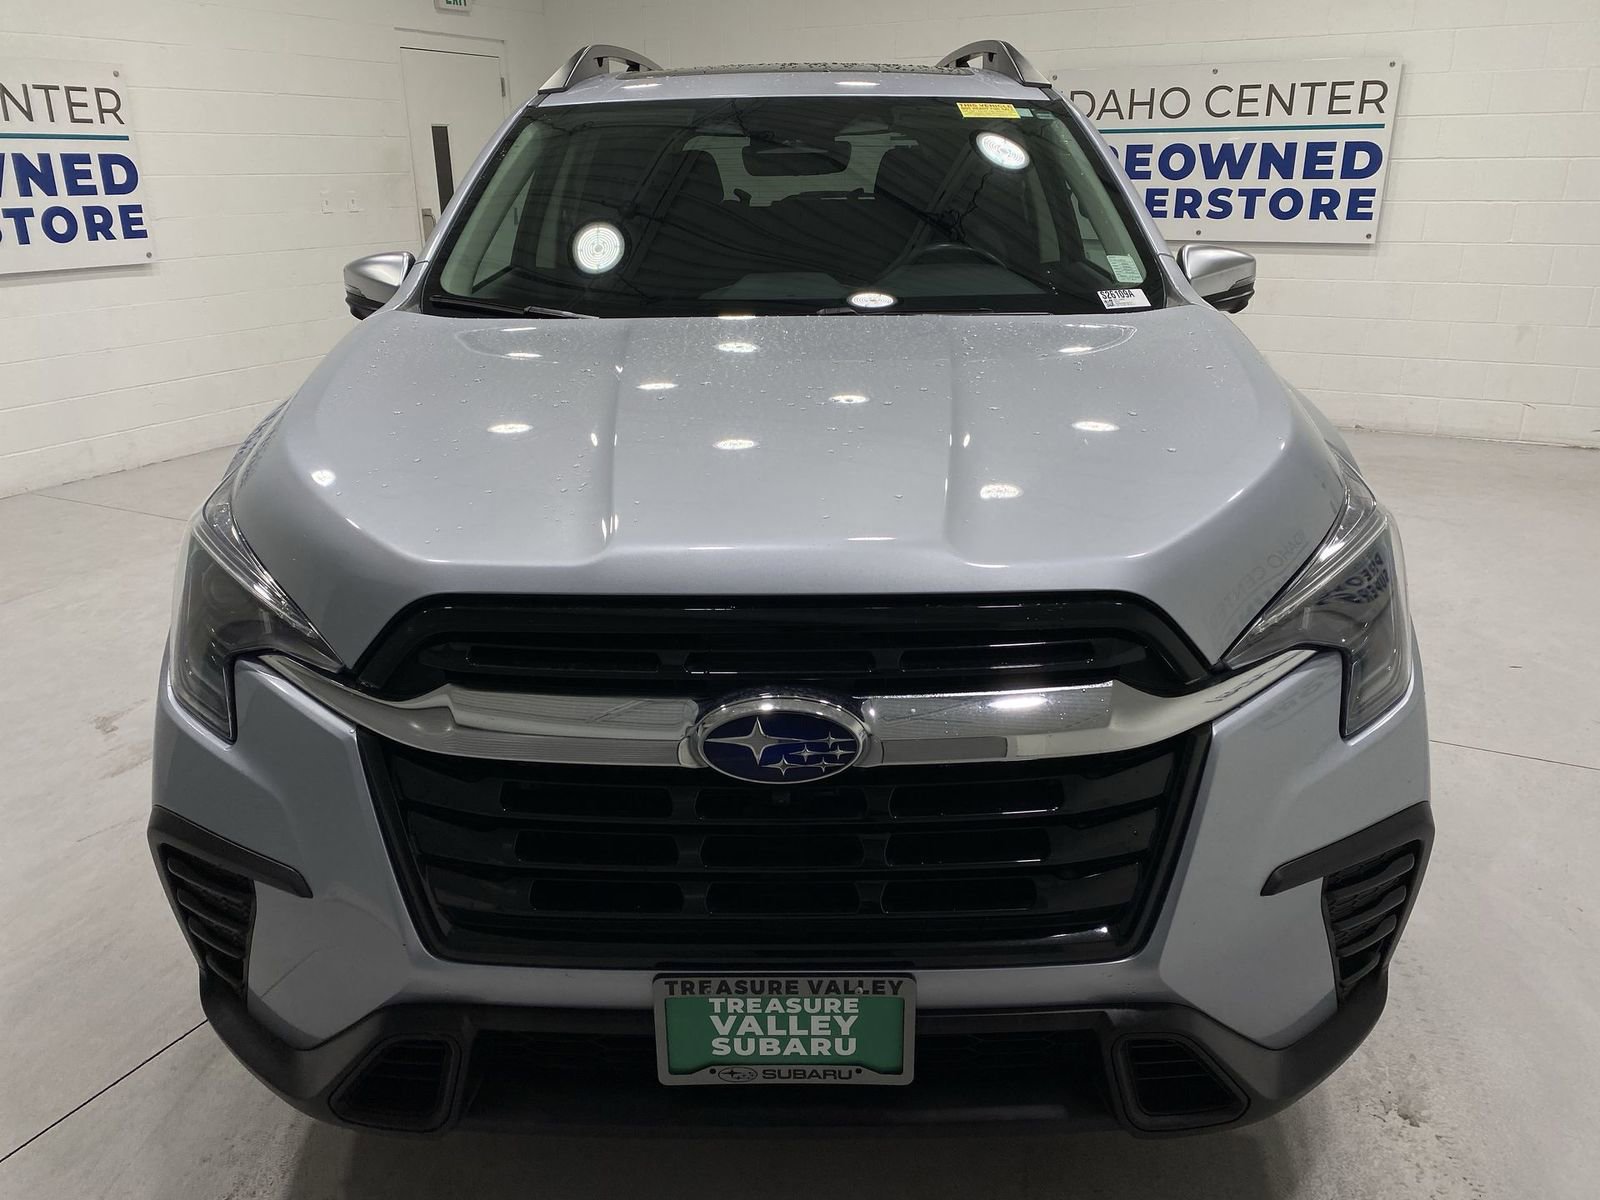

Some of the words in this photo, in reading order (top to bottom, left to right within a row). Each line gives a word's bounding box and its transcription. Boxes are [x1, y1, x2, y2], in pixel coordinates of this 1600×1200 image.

[1061, 86, 1191, 121] DAHO
[1205, 80, 1389, 118] CENTER
[1109, 141, 1383, 181] EOWNED
[0, 152, 139, 198] NED
[0, 204, 149, 245] TORE
[1100, 289, 1136, 300] S26109A
[664, 980, 799, 996] TREASURE
[807, 980, 904, 996] VALLEY
[708, 997, 860, 1014] TREASURE
[709, 1015, 859, 1036] VALLEY
[711, 1037, 857, 1056] SUBARU
[761, 1068, 853, 1080] SUBARU
